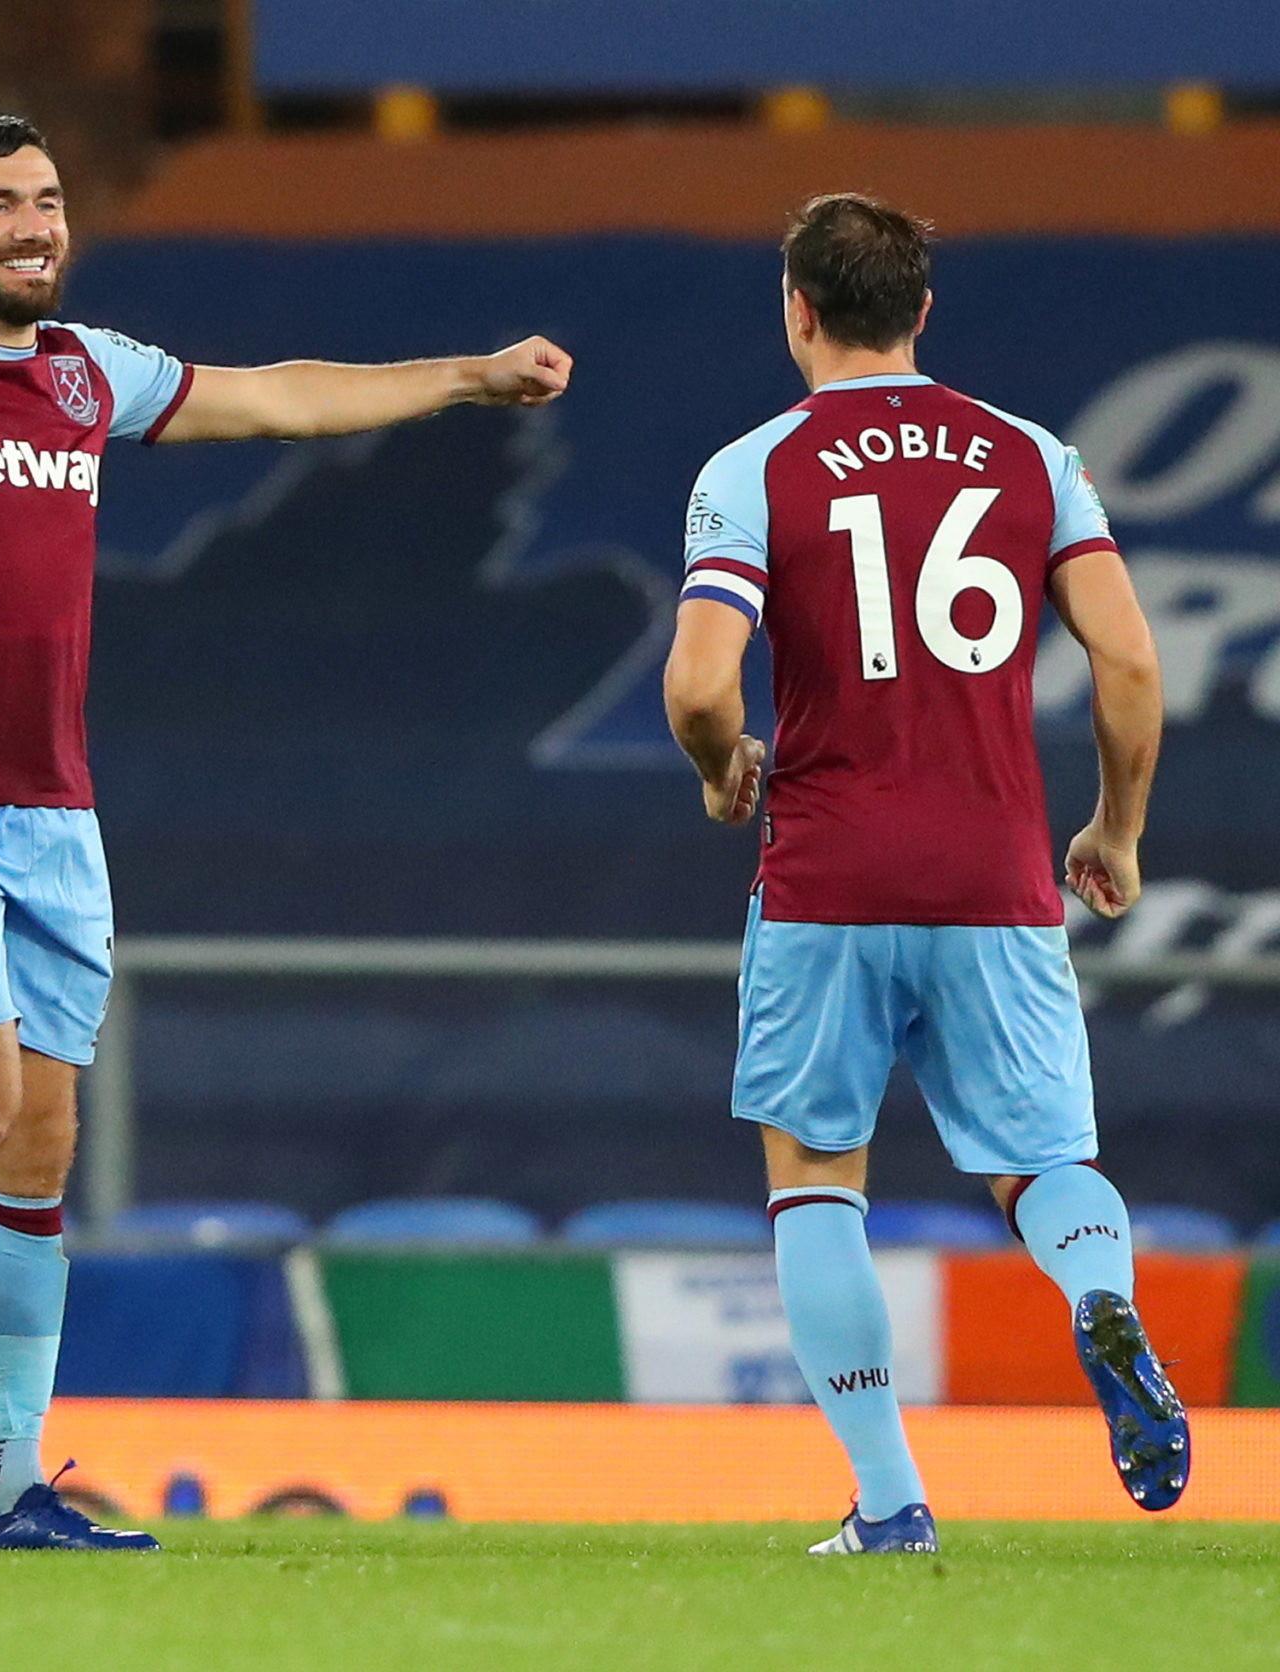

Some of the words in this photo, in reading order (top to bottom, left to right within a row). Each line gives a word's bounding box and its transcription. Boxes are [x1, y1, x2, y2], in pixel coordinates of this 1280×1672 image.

[817, 423, 995, 481] NOBLE
[828, 487, 1024, 681] 16
[1056, 1224, 1119, 1250] WHU
[828, 1367, 890, 1394] WHU
